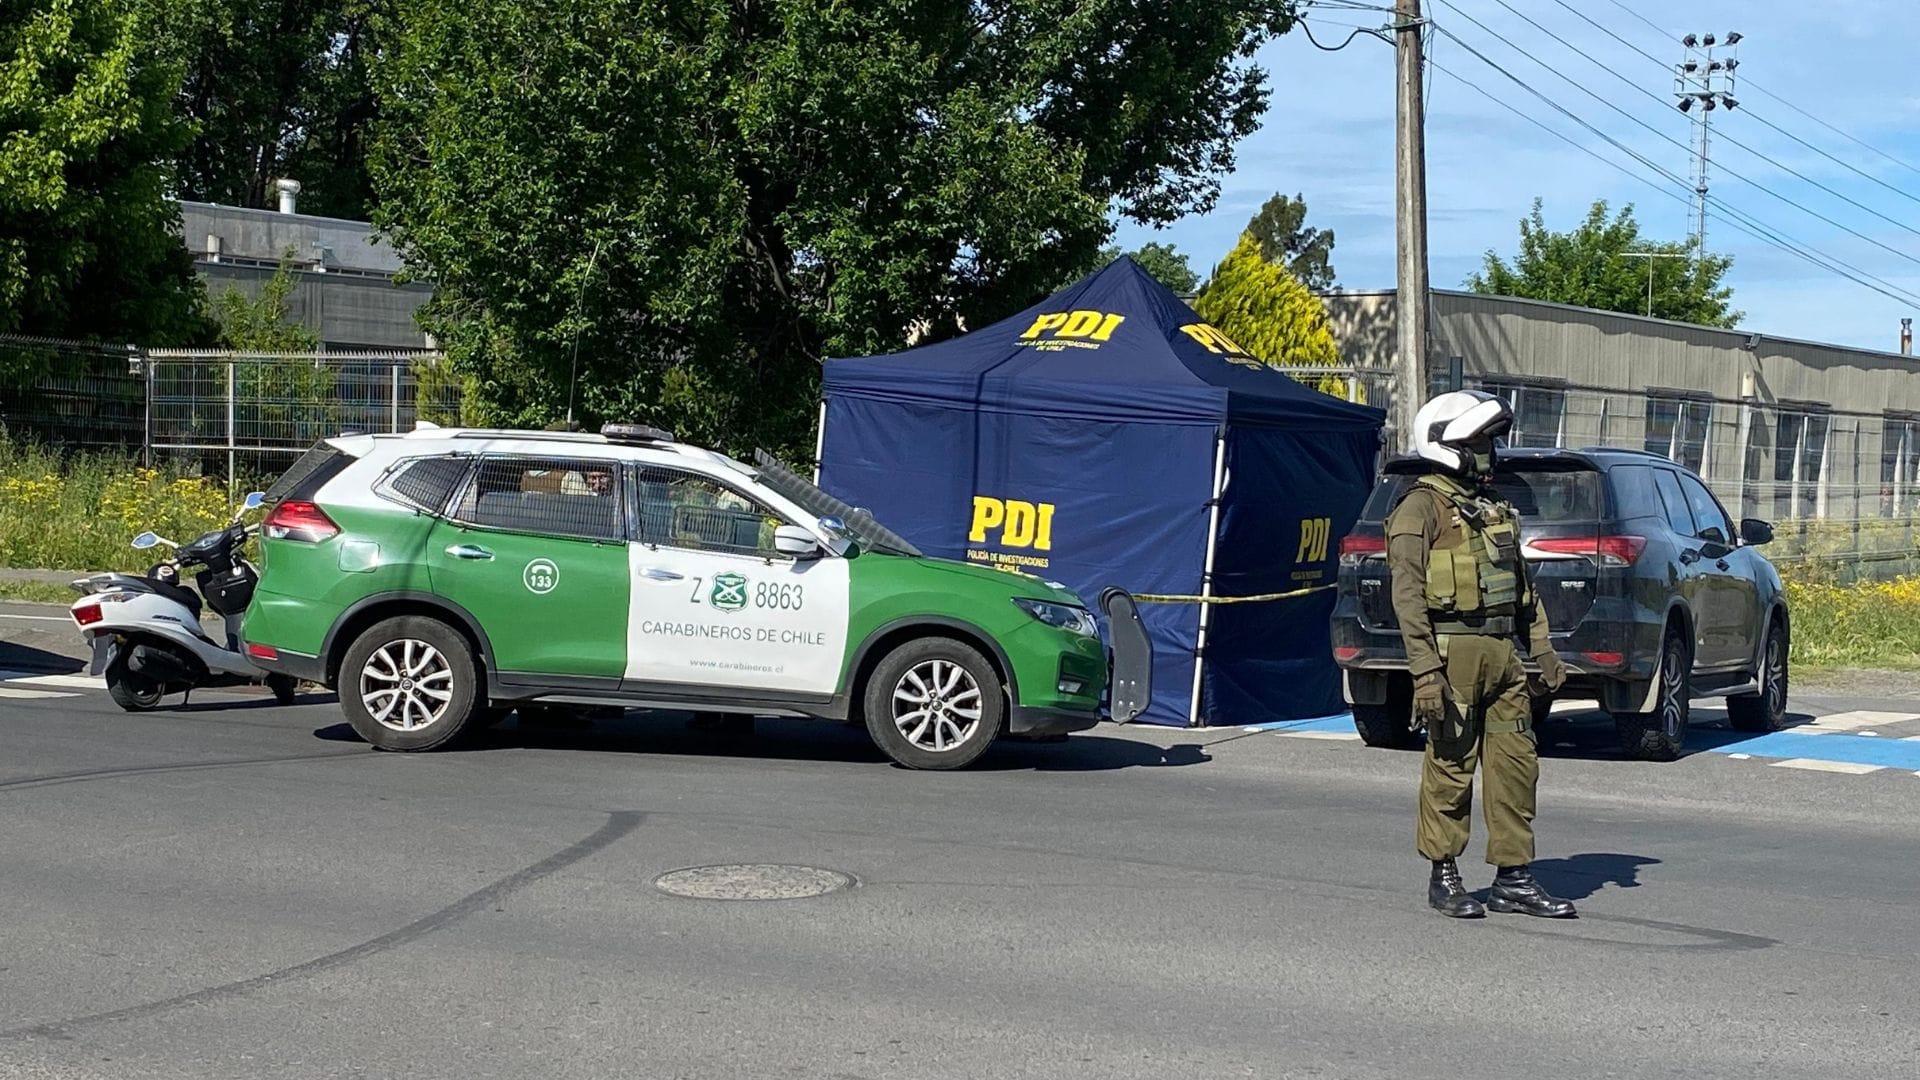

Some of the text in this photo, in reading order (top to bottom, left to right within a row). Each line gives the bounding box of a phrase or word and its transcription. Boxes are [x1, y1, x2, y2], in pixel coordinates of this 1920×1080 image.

[1019, 310, 1125, 341] PDI
[968, 496, 1055, 550] PDI
[1296, 518, 1330, 563] PDI
[967, 549, 1049, 568] POLICÍA DE INVESTIGACIONES
[531, 575, 552, 588] 133
[690, 577, 803, 611] Z 8863
[642, 620, 826, 645] CARABINEROS DE CHILE
[690, 660, 784, 673] www.carabineros.cl
